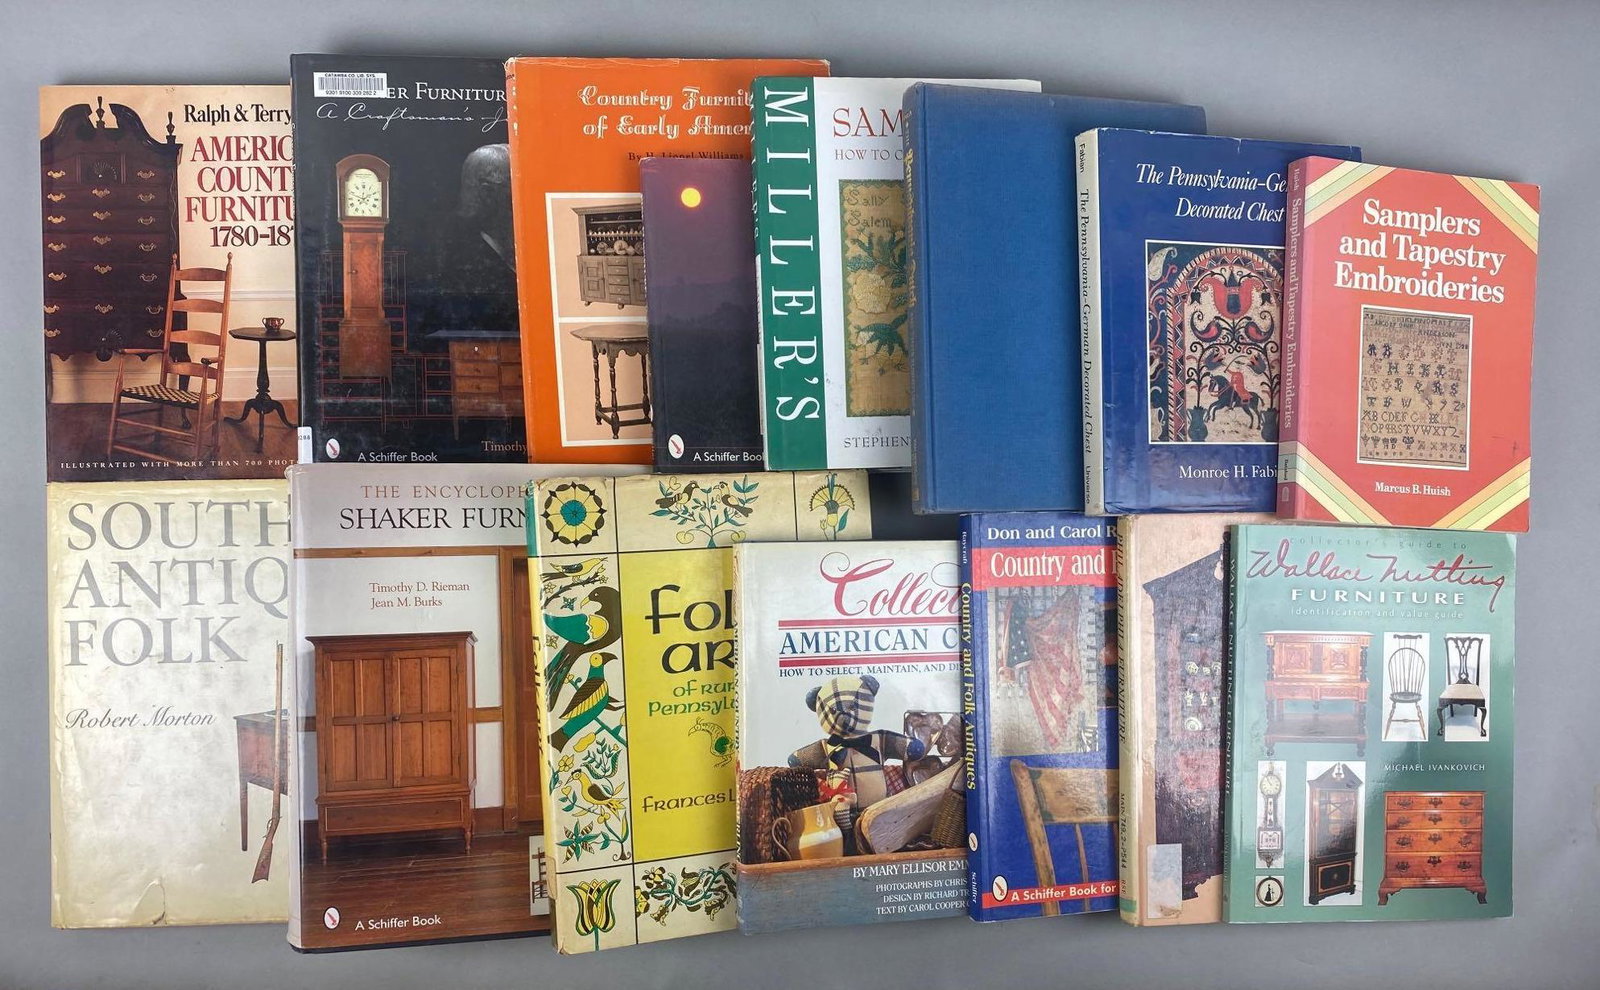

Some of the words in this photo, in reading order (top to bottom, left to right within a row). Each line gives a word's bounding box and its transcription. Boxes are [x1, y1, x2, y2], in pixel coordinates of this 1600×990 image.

[384, 87, 410, 99] ER
[577, 85, 673, 110] Country
[184, 104, 230, 126] Ralph
[233, 104, 249, 122] &
[251, 104, 291, 125] Terry
[481, 106, 508, 132] J
[583, 115, 608, 139] of
[616, 114, 680, 139] Early
[833, 106, 903, 138] SAM
[190, 135, 293, 162] AMERIC
[835, 149, 869, 161] HOW
[871, 149, 891, 161] TO
[197, 166, 293, 193] COUNT
[1136, 163, 1164, 185] The
[1167, 166, 1288, 193] Pennsylvania-Ge
[1080, 189, 1090, 213] The
[1175, 197, 1246, 220] Decorated
[1247, 202, 1285, 222] Chest
[1289, 198, 1302, 258] Samplers
[1362, 198, 1481, 238] Samplers
[210, 225, 293, 247] 1780-18
[763, 86, 820, 422] MILLER'S
[1339, 231, 1387, 259] and
[1392, 233, 1507, 276] Tapestry
[1289, 259, 1299, 283] and
[1333, 260, 1505, 304] Embroideries
[1286, 283, 1299, 340] Tapestry
[1083, 360, 1092, 419] Decorated
[1284, 342, 1297, 429] Embroideries
[481, 440, 528, 454] Timothy
[843, 435, 909, 449] STEPHEN
[1084, 421, 1093, 454] Chest
[60, 461, 136, 469] ILLUSTRATED
[357, 452, 366, 462] A
[369, 451, 407, 462] Schiffer
[410, 451, 438, 462] Book
[693, 452, 702, 462] A
[703, 451, 740, 462] Schiffer
[1179, 465, 1230, 479] Monroe
[1233, 464, 1249, 478] H.
[1252, 464, 1277, 478] Fabi
[361, 485, 400, 499] THE
[1374, 481, 1410, 495] Marcus
[1412, 484, 1423, 495] B.
[1423, 485, 1451, 497] Huish
[339, 507, 453, 530] SHAKER
[987, 526, 1020, 540] Don
[1025, 525, 1055, 539] and
[1060, 524, 1101, 538] Carol
[1453, 542, 1467, 550] to
[990, 551, 1066, 582] Country
[1072, 548, 1106, 576] and
[1246, 538, 1374, 582] Wallace
[62, 556, 288, 620] ANTIQ
[369, 582, 414, 593] Timothy
[416, 581, 428, 591] D.
[432, 581, 470, 591] Rieman
[1291, 589, 1465, 605] FURNITURE
[370, 597, 394, 610] Jean
[397, 597, 412, 607] M.
[414, 596, 443, 607] Burks
[961, 582, 972, 644] Country
[1376, 609, 1395, 617] and
[1400, 609, 1429, 618] value
[1434, 610, 1464, 620] guide
[64, 616, 248, 667] FOLK
[779, 628, 929, 655] AMERICAN
[779, 668, 805, 677] HOW
[808, 668, 823, 676] TO
[826, 666, 863, 675] SELECT,
[867, 664, 921, 674] MAINTAIN,
[924, 663, 946, 672] AND
[963, 649, 974, 677] and
[964, 683, 976, 715] Folk
[65, 708, 140, 729] Robert
[143, 705, 216, 728] Morton
[964, 719, 977, 790] Antiques
[1384, 763, 1424, 771] MICHAEL
[1428, 763, 1485, 771] IVANKOVICH
[853, 867, 868, 878] BY
[869, 864, 901, 877] MARY
[902, 861, 947, 875] ELLISOR
[875, 881, 933, 892] PHOTOGRAPHS
[934, 879, 944, 888] BY
[944, 877, 967, 887] CHRIS
[883, 893, 912, 903] DESIGN
[913, 892, 925, 901] BY
[925, 890, 958, 900] RICHARD
[1011, 891, 1020, 902] A
[1023, 888, 1066, 901] Schiffer
[1069, 884, 1098, 897] Book
[1100, 883, 1117, 894] for
[876, 906, 897, 915] TEXT
[897, 905, 908, 914] BY
[908, 903, 934, 913] CAROL
[935, 900, 966, 910] COOPER
[355, 921, 365, 930] A
[368, 917, 409, 929] Schiffer
[412, 914, 442, 927] Book
